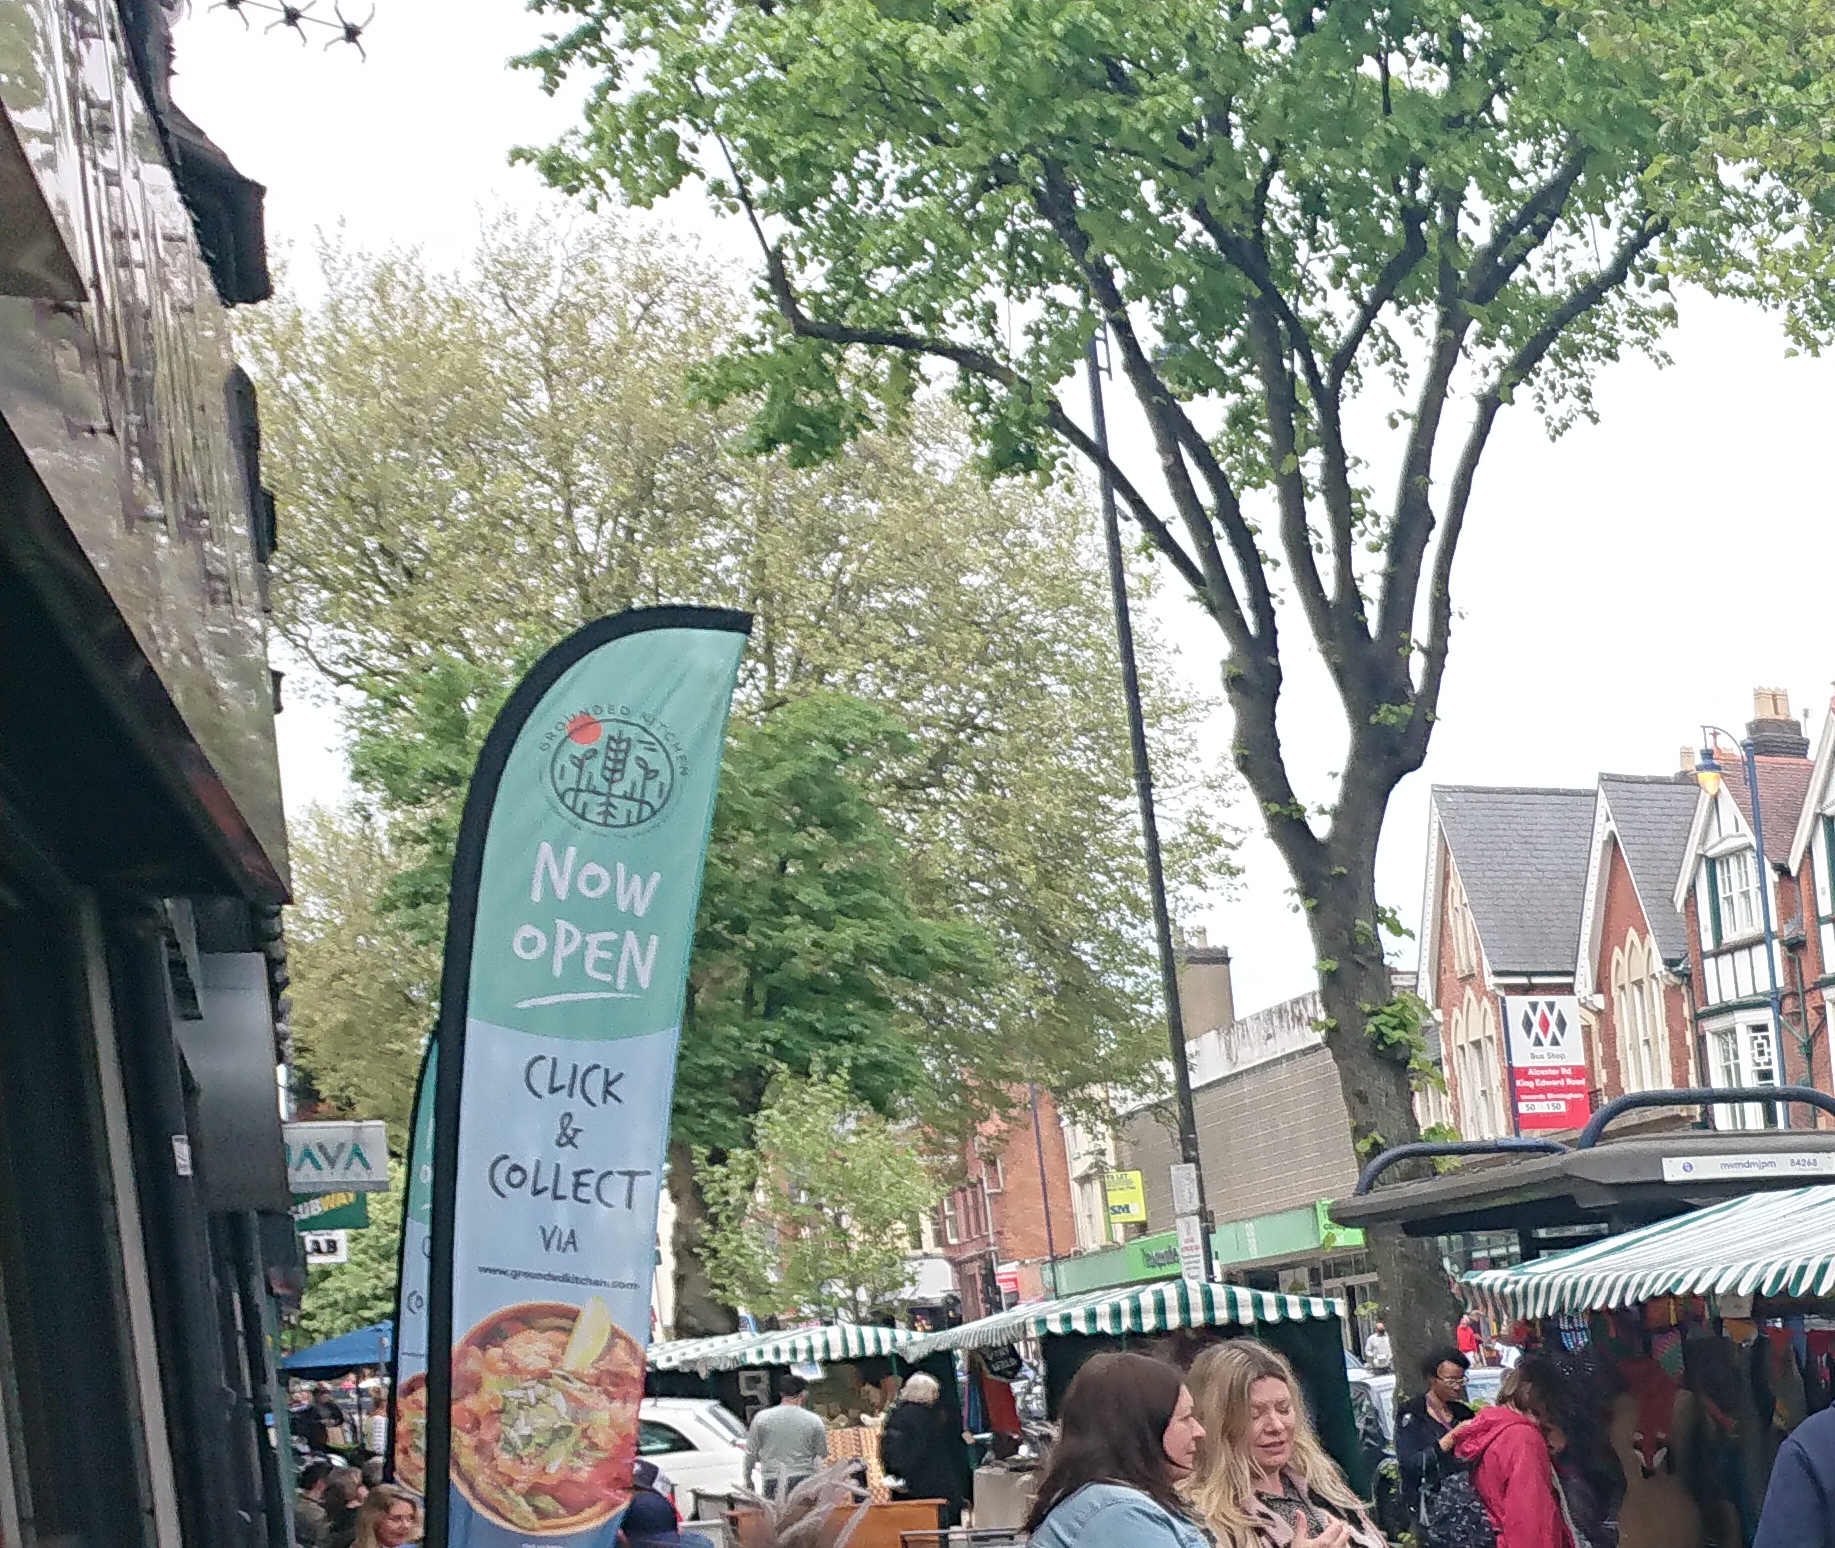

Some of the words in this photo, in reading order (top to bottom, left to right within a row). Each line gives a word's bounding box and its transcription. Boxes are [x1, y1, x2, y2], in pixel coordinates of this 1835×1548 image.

[1529, 1052, 1545, 1060] Bus
[1547, 1051, 1566, 1060] Stop
[524, 1054, 624, 1108] CLICK
[1515, 1079, 1535, 1089] King
[1535, 1078, 1565, 1087] Edward
[1566, 1077, 1586, 1086] Road
[1525, 1103, 1536, 1111] 50
[1546, 1102, 1562, 1111] 150
[555, 1111, 584, 1150] &
[488, 1153, 652, 1211] COLLECT
[538, 1224, 579, 1254] VIA
